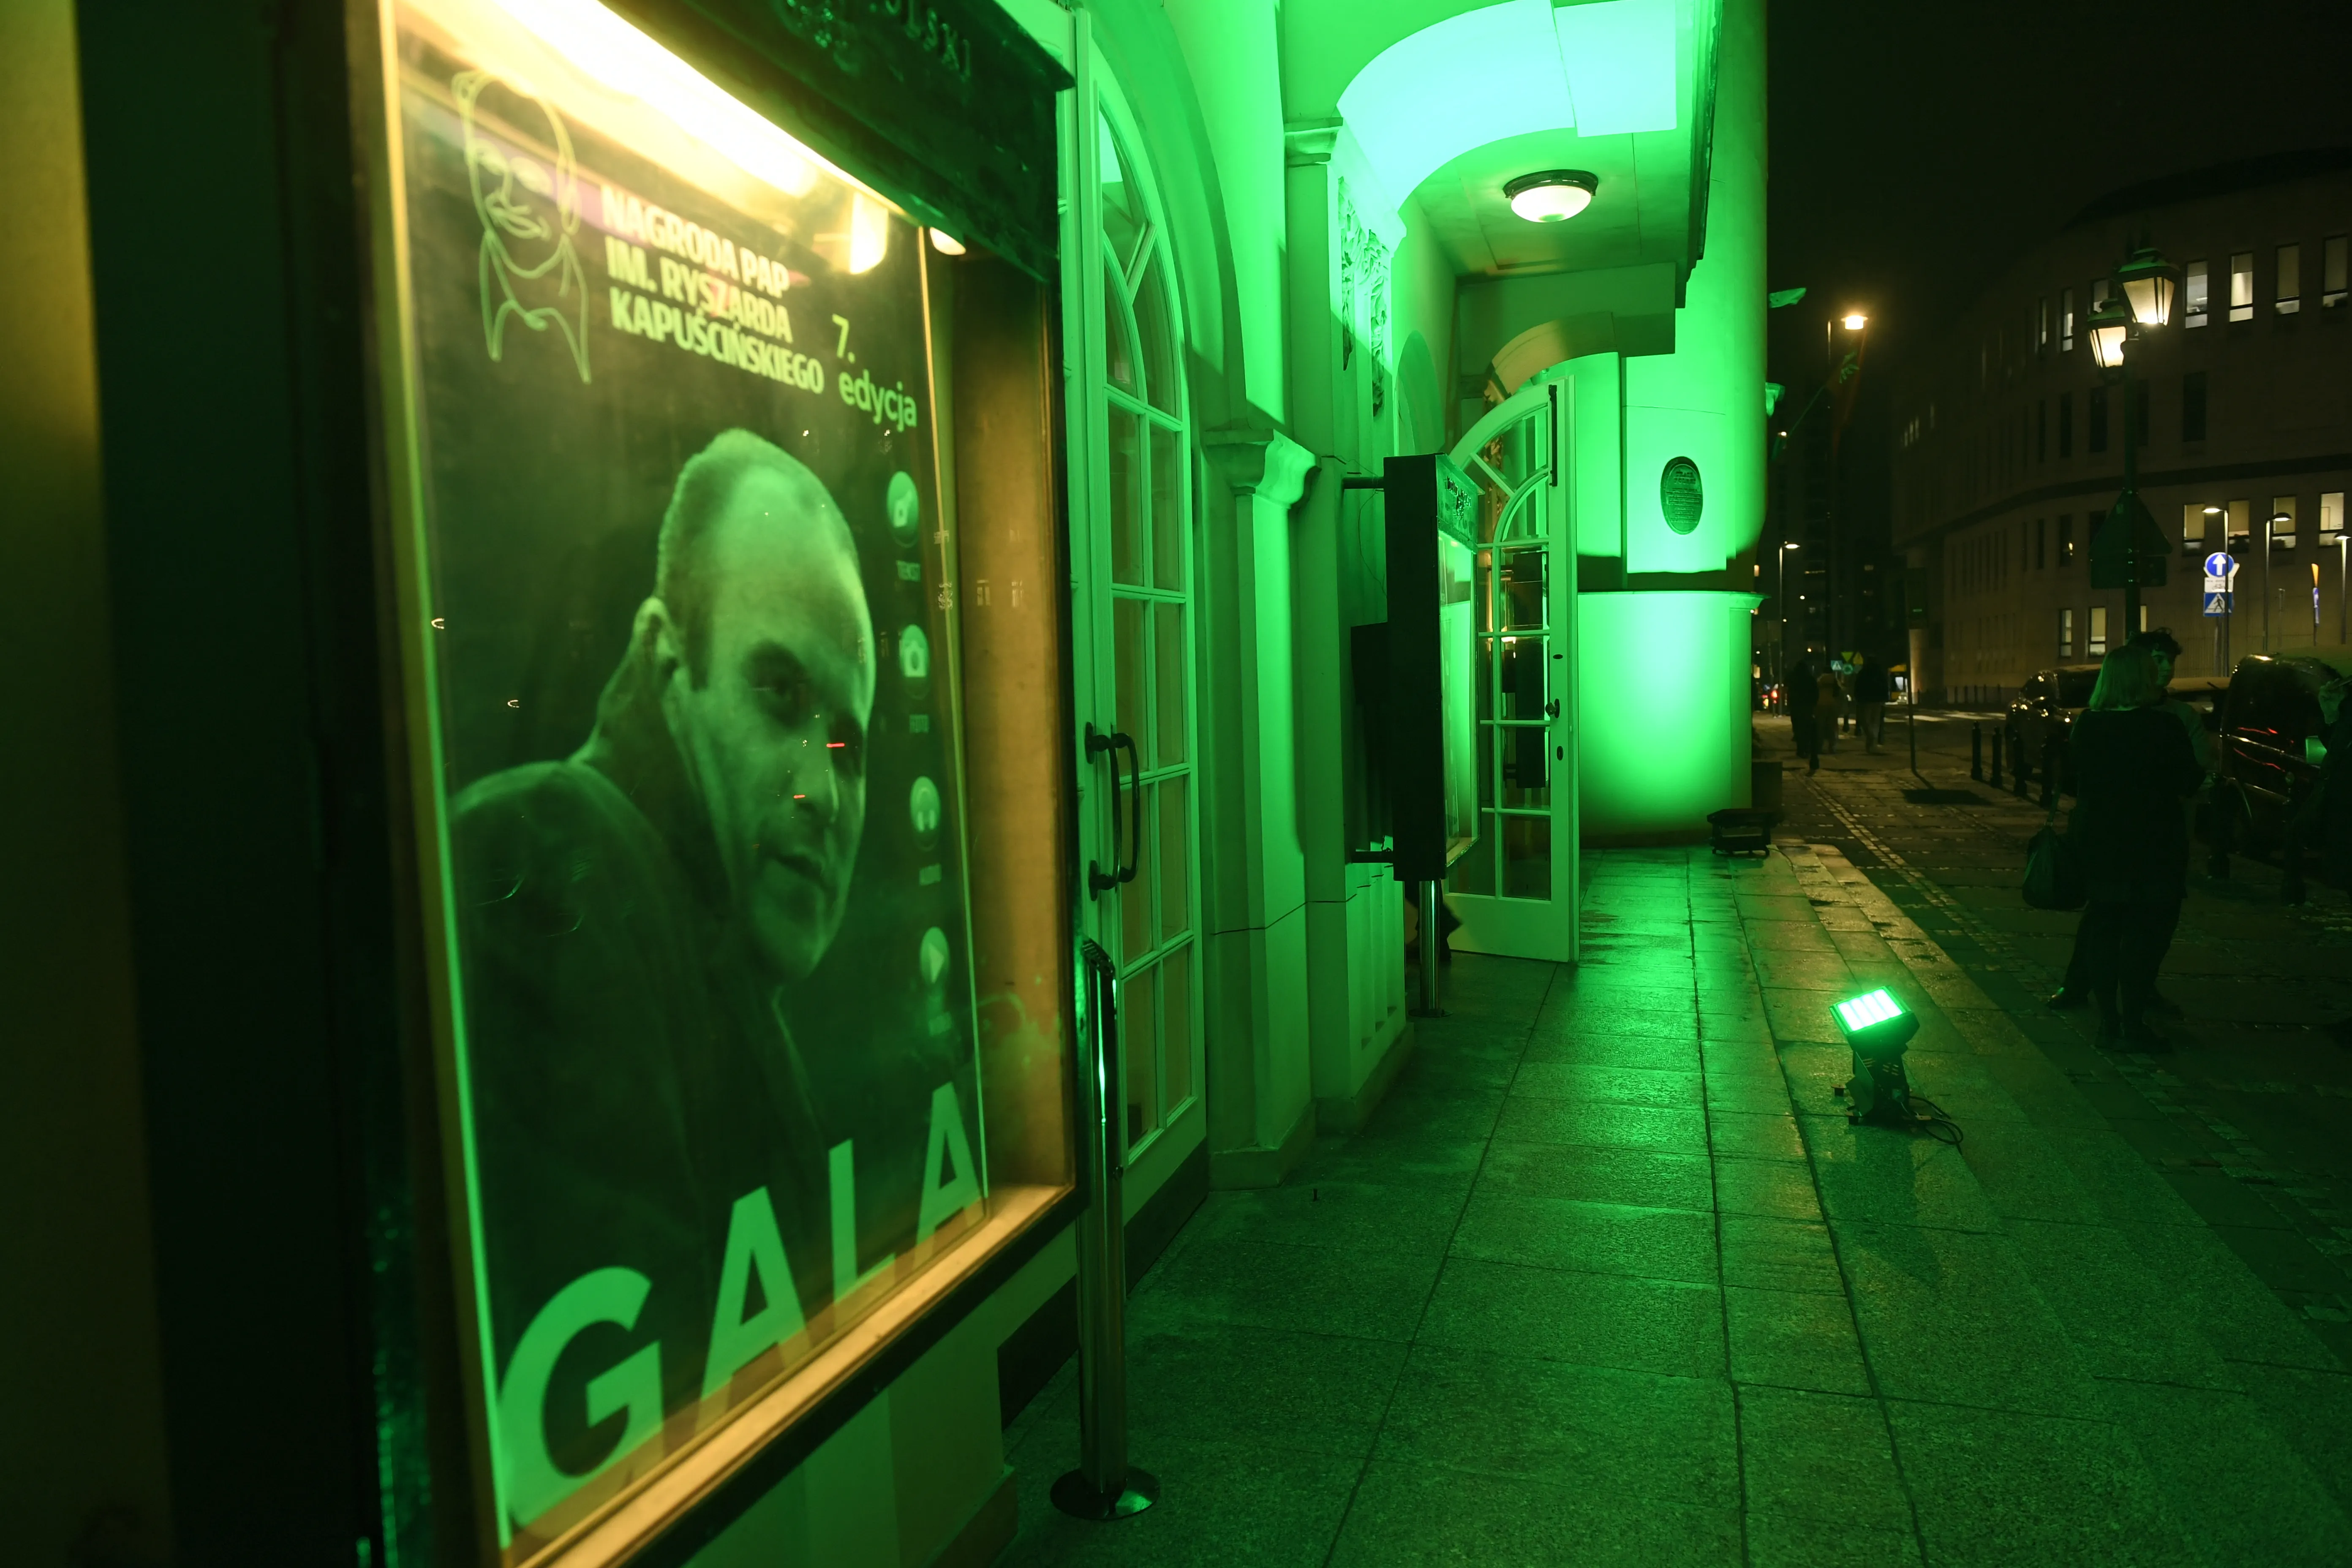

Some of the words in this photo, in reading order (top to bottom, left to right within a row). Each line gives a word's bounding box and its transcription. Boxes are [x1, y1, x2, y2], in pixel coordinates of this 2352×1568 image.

[600, 184, 740, 280] NAGRODA
[740, 247, 789, 298] PAP
[604, 235, 658, 294] IM.
[659, 256, 793, 343] RYSZARDA
[610, 286, 825, 395] KAPUŚCIŃSKIEGO
[832, 314, 855, 363] 7.
[838, 369, 917, 432] edycja
[498, 1081, 986, 1538] GALA
